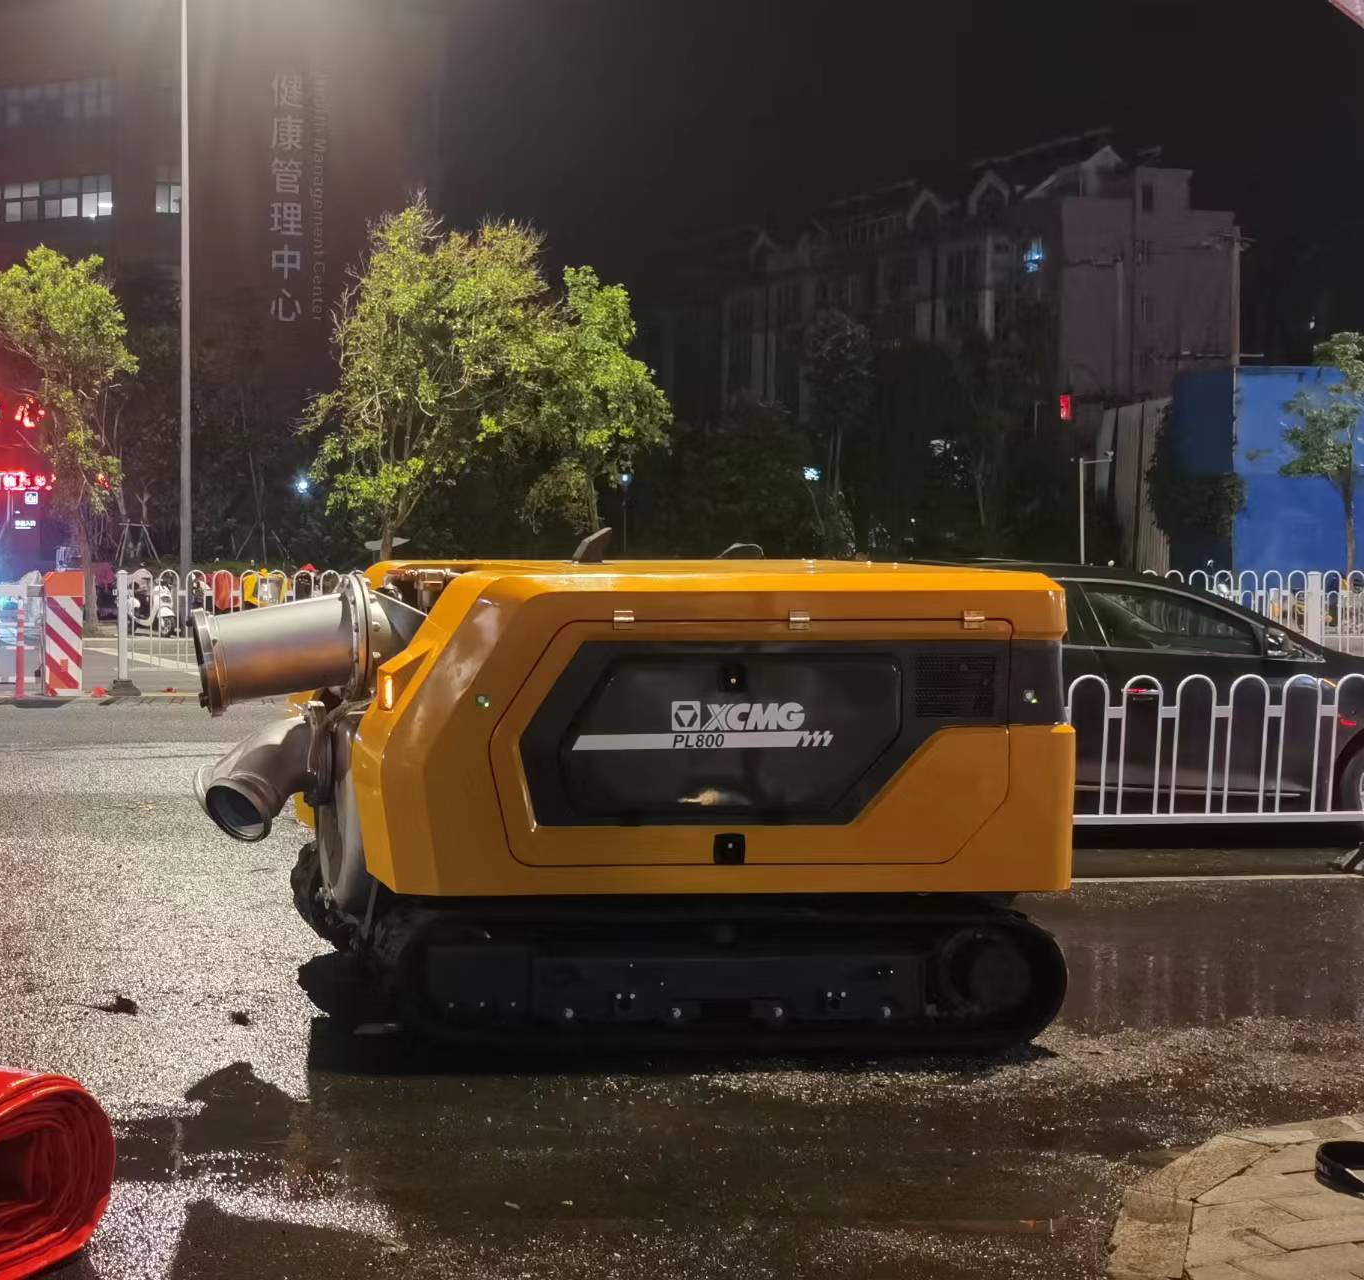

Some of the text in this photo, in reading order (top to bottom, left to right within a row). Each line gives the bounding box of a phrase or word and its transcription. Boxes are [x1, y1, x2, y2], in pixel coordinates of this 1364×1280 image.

[269, 72, 304, 323] 健康管理中心
[310, 138, 327, 256] Management
[311, 261, 326, 321] Center
[672, 733, 725, 749] PL800
[702, 702, 806, 731] XCMG
